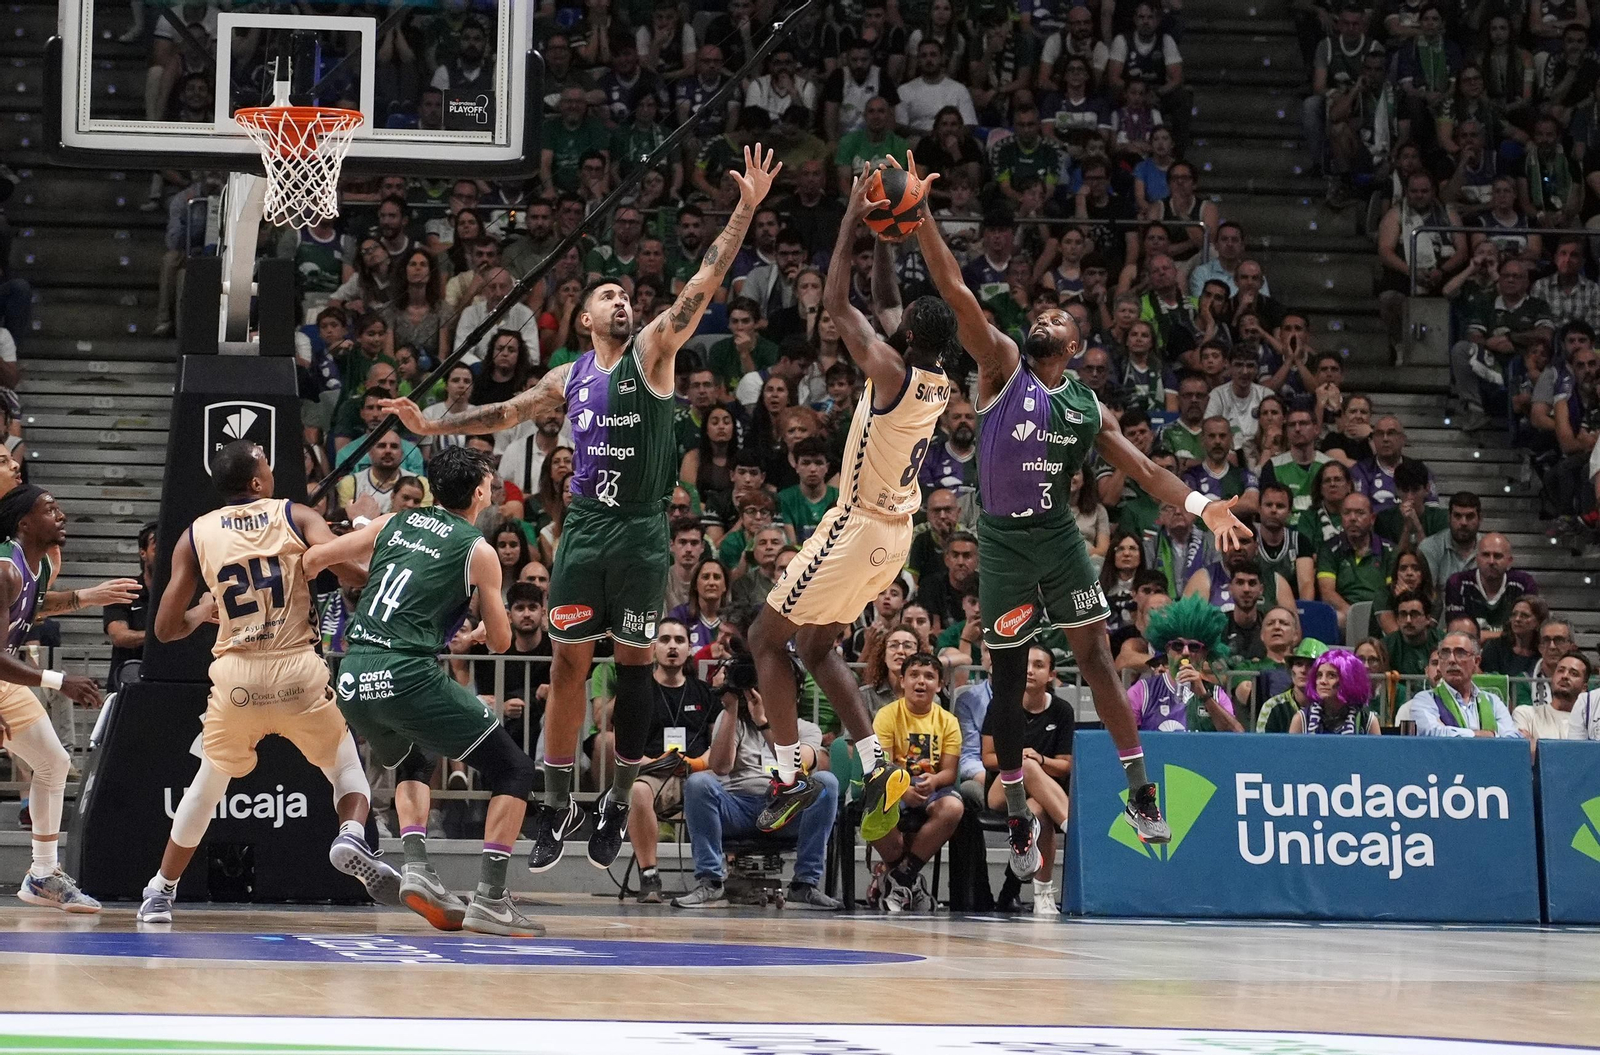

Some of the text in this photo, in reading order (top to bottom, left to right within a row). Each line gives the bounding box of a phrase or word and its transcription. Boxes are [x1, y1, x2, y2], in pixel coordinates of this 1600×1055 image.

[449, 105, 483, 113] PLAYOFF
[596, 411, 641, 428] Unicaja
[1036, 429, 1078, 446] Unicaja
[900, 437, 929, 487] 8
[1038, 482, 1053, 510] 3
[220, 511, 270, 532] MORIN
[217, 555, 286, 620] 24
[368, 563, 412, 623] 14
[359, 670, 393, 683] COSTA
[359, 681, 394, 692] DEL SOL
[251, 692, 276, 701] Costa
[359, 689, 395, 701] MÁLAGA
[164, 784, 308, 828] Uicaja
[1235, 772, 1509, 819] Fundación
[1237, 820, 1435, 880] Unicaja
